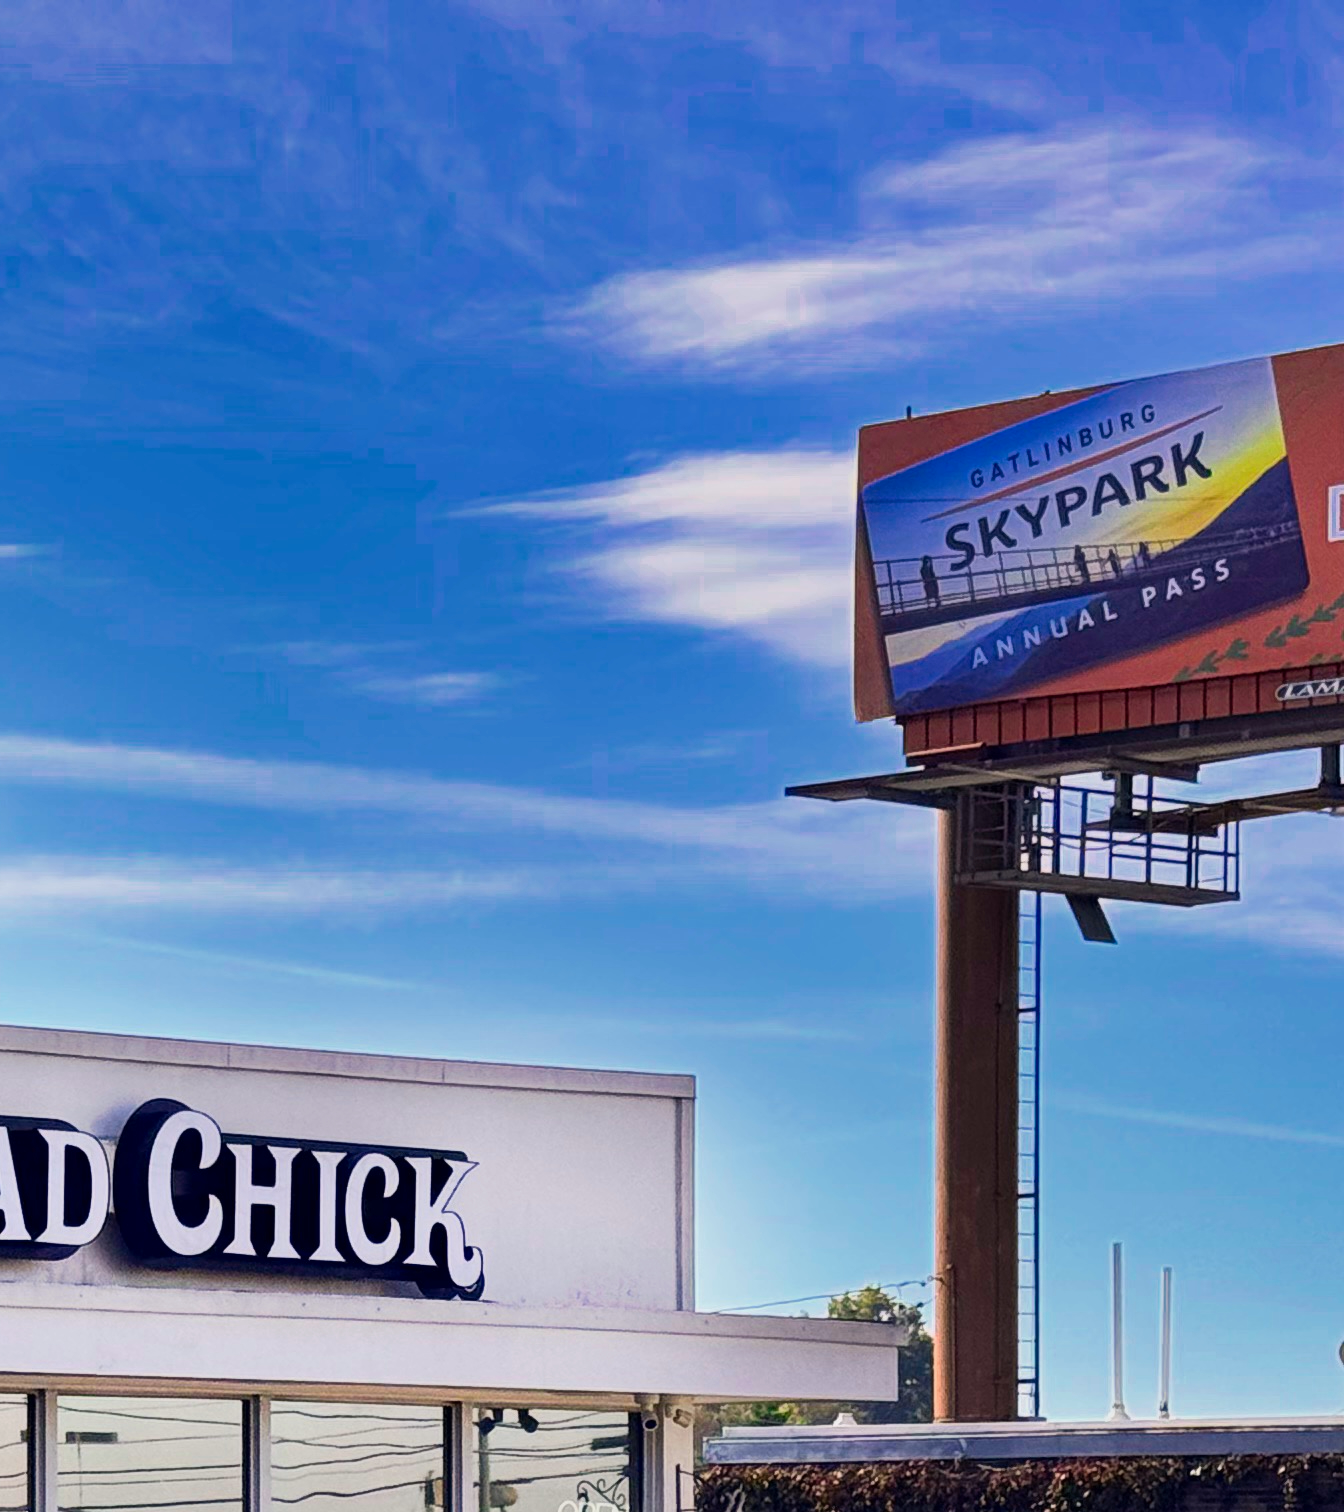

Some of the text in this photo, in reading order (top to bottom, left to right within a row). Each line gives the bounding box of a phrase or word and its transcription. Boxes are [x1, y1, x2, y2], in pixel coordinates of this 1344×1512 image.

[944, 430, 1214, 573] SKYPARK
[970, 403, 1157, 490] GATLINBURG
[970, 557, 1233, 671] ANNUAL PASS
[147, 1109, 484, 1291] CHICK
